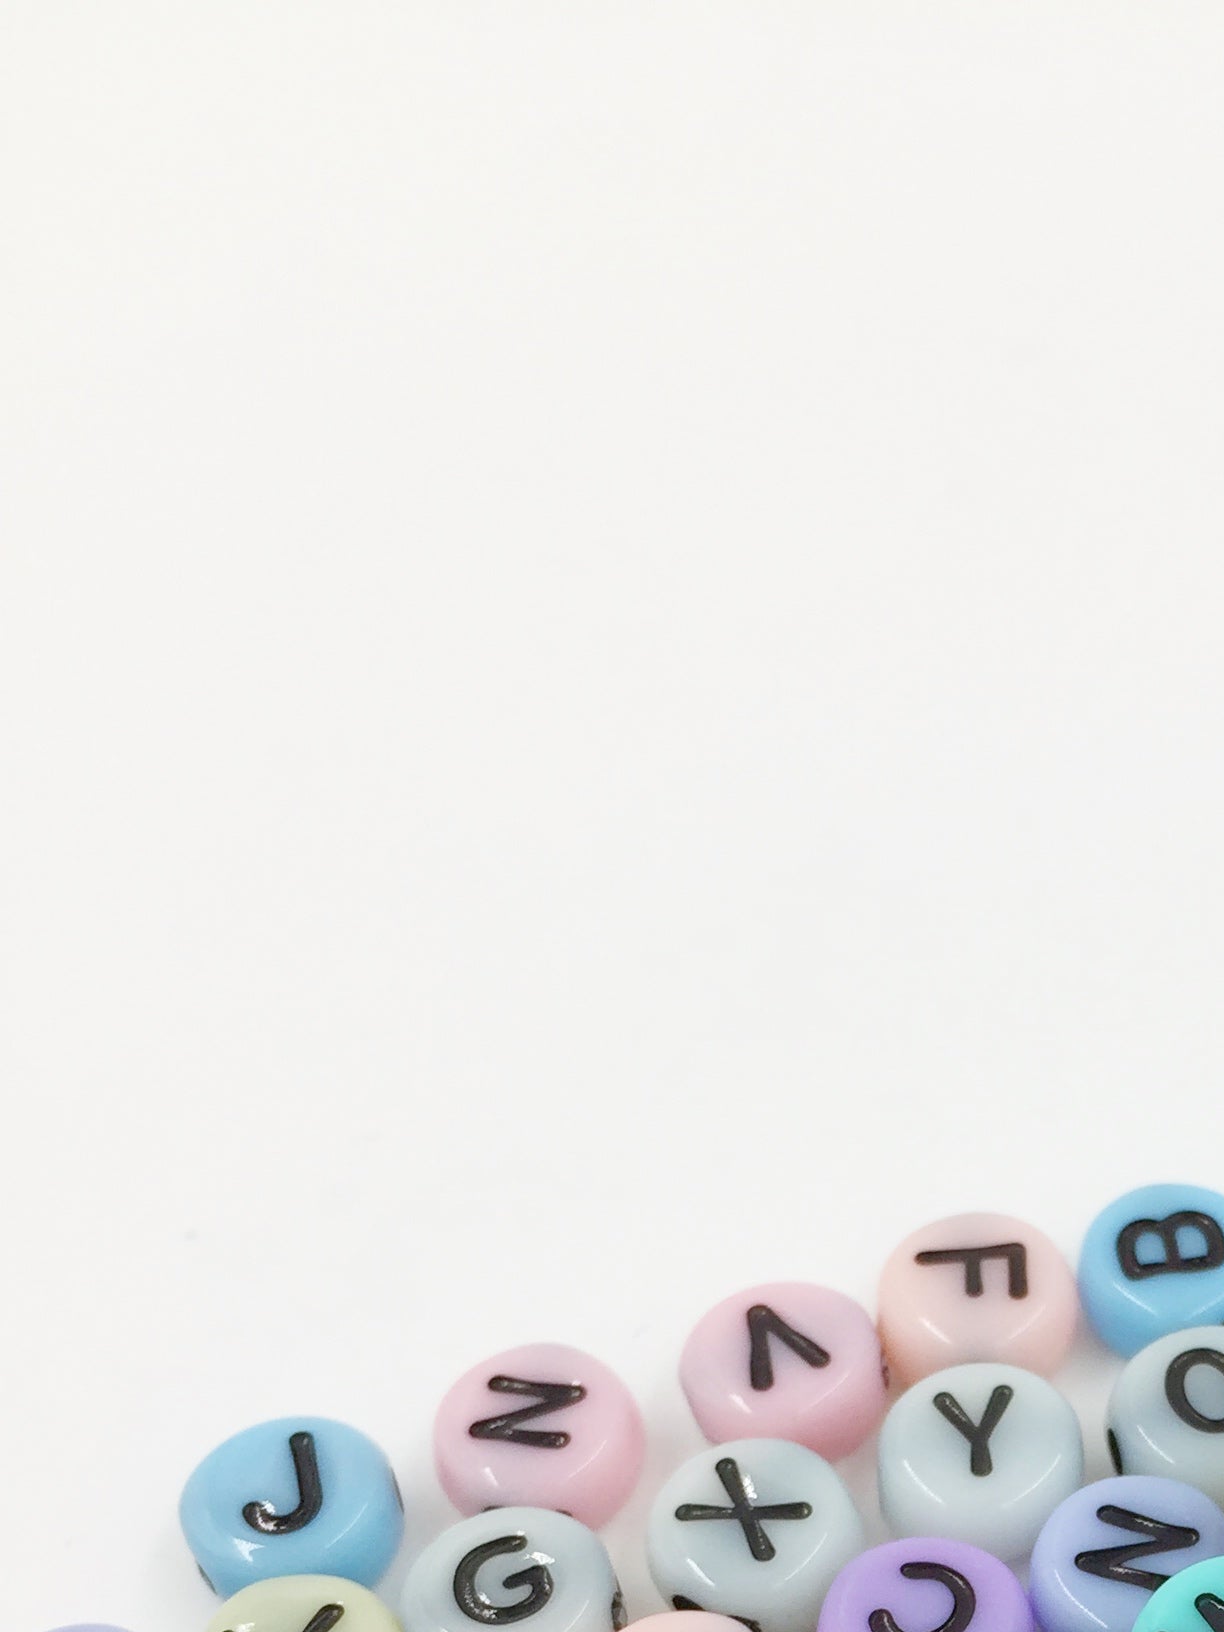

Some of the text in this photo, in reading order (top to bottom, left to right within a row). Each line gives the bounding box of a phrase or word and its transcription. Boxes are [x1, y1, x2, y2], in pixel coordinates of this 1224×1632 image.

[916, 1242, 1027, 1298] F
[746, 1305, 830, 1391] V
[933, 1384, 1013, 1477] Y
[241, 1431, 324, 1536] J
[674, 1457, 812, 1562] X
[452, 1535, 554, 1626] G
